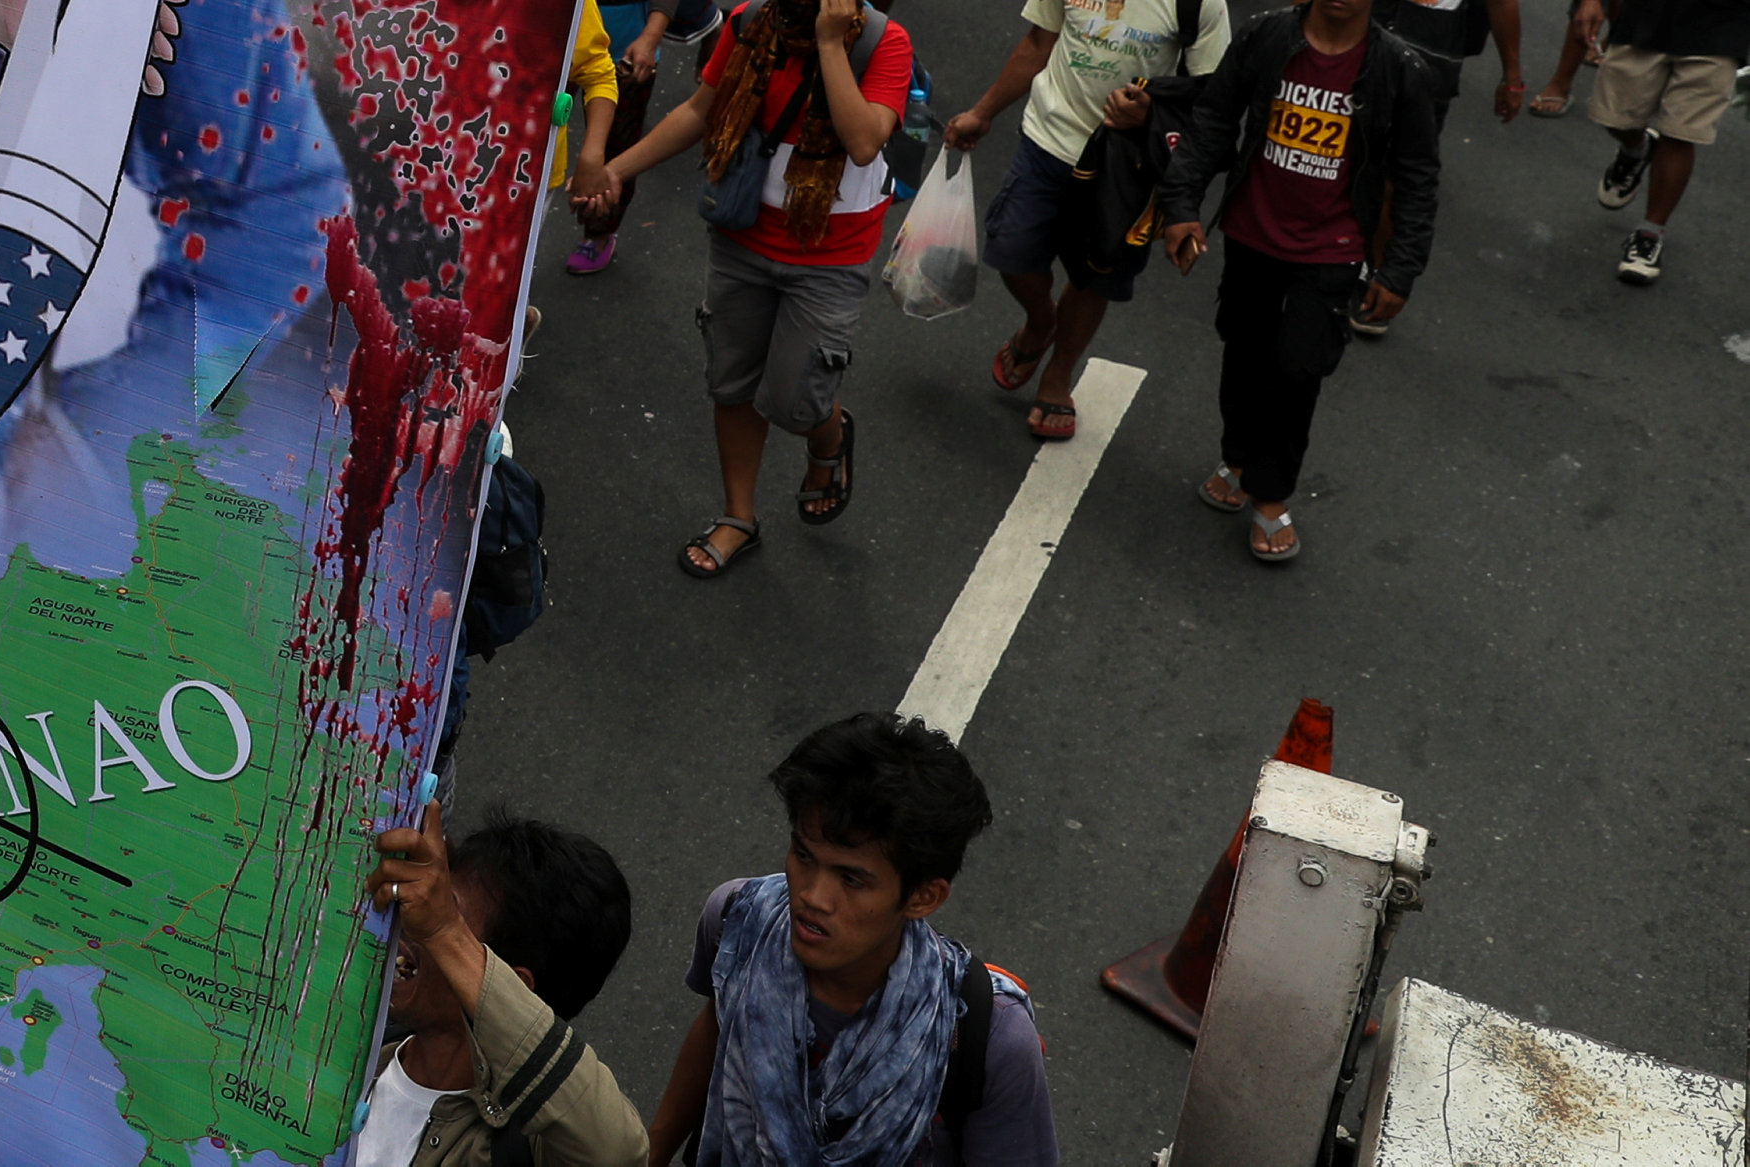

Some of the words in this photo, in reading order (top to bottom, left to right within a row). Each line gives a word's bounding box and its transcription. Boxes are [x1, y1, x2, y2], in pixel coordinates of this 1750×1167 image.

[1272, 109, 1344, 149] 1922
[1263, 139, 1302, 171] ONE
[1298, 153, 1341, 169] WORLD
[1296, 162, 1338, 180] BRAND
[204, 492, 270, 511] SURIGAO
[238, 506, 266, 518] DEL
[214, 509, 266, 526] NORTE
[28, 606, 59, 622] DEL
[59, 613, 115, 632] NORTE
[31, 597, 96, 618] AGUSAN
[71, 924, 102, 941] Tagum
[173, 933, 232, 958] Nabunturan
[160, 962, 290, 1016] COMPOSTELA
[185, 985, 256, 1016] VALLEY
[225, 1072, 288, 1109] DAVAO
[220, 1086, 312, 1138] ORIENTAL
[207, 1126, 232, 1142] Mati
